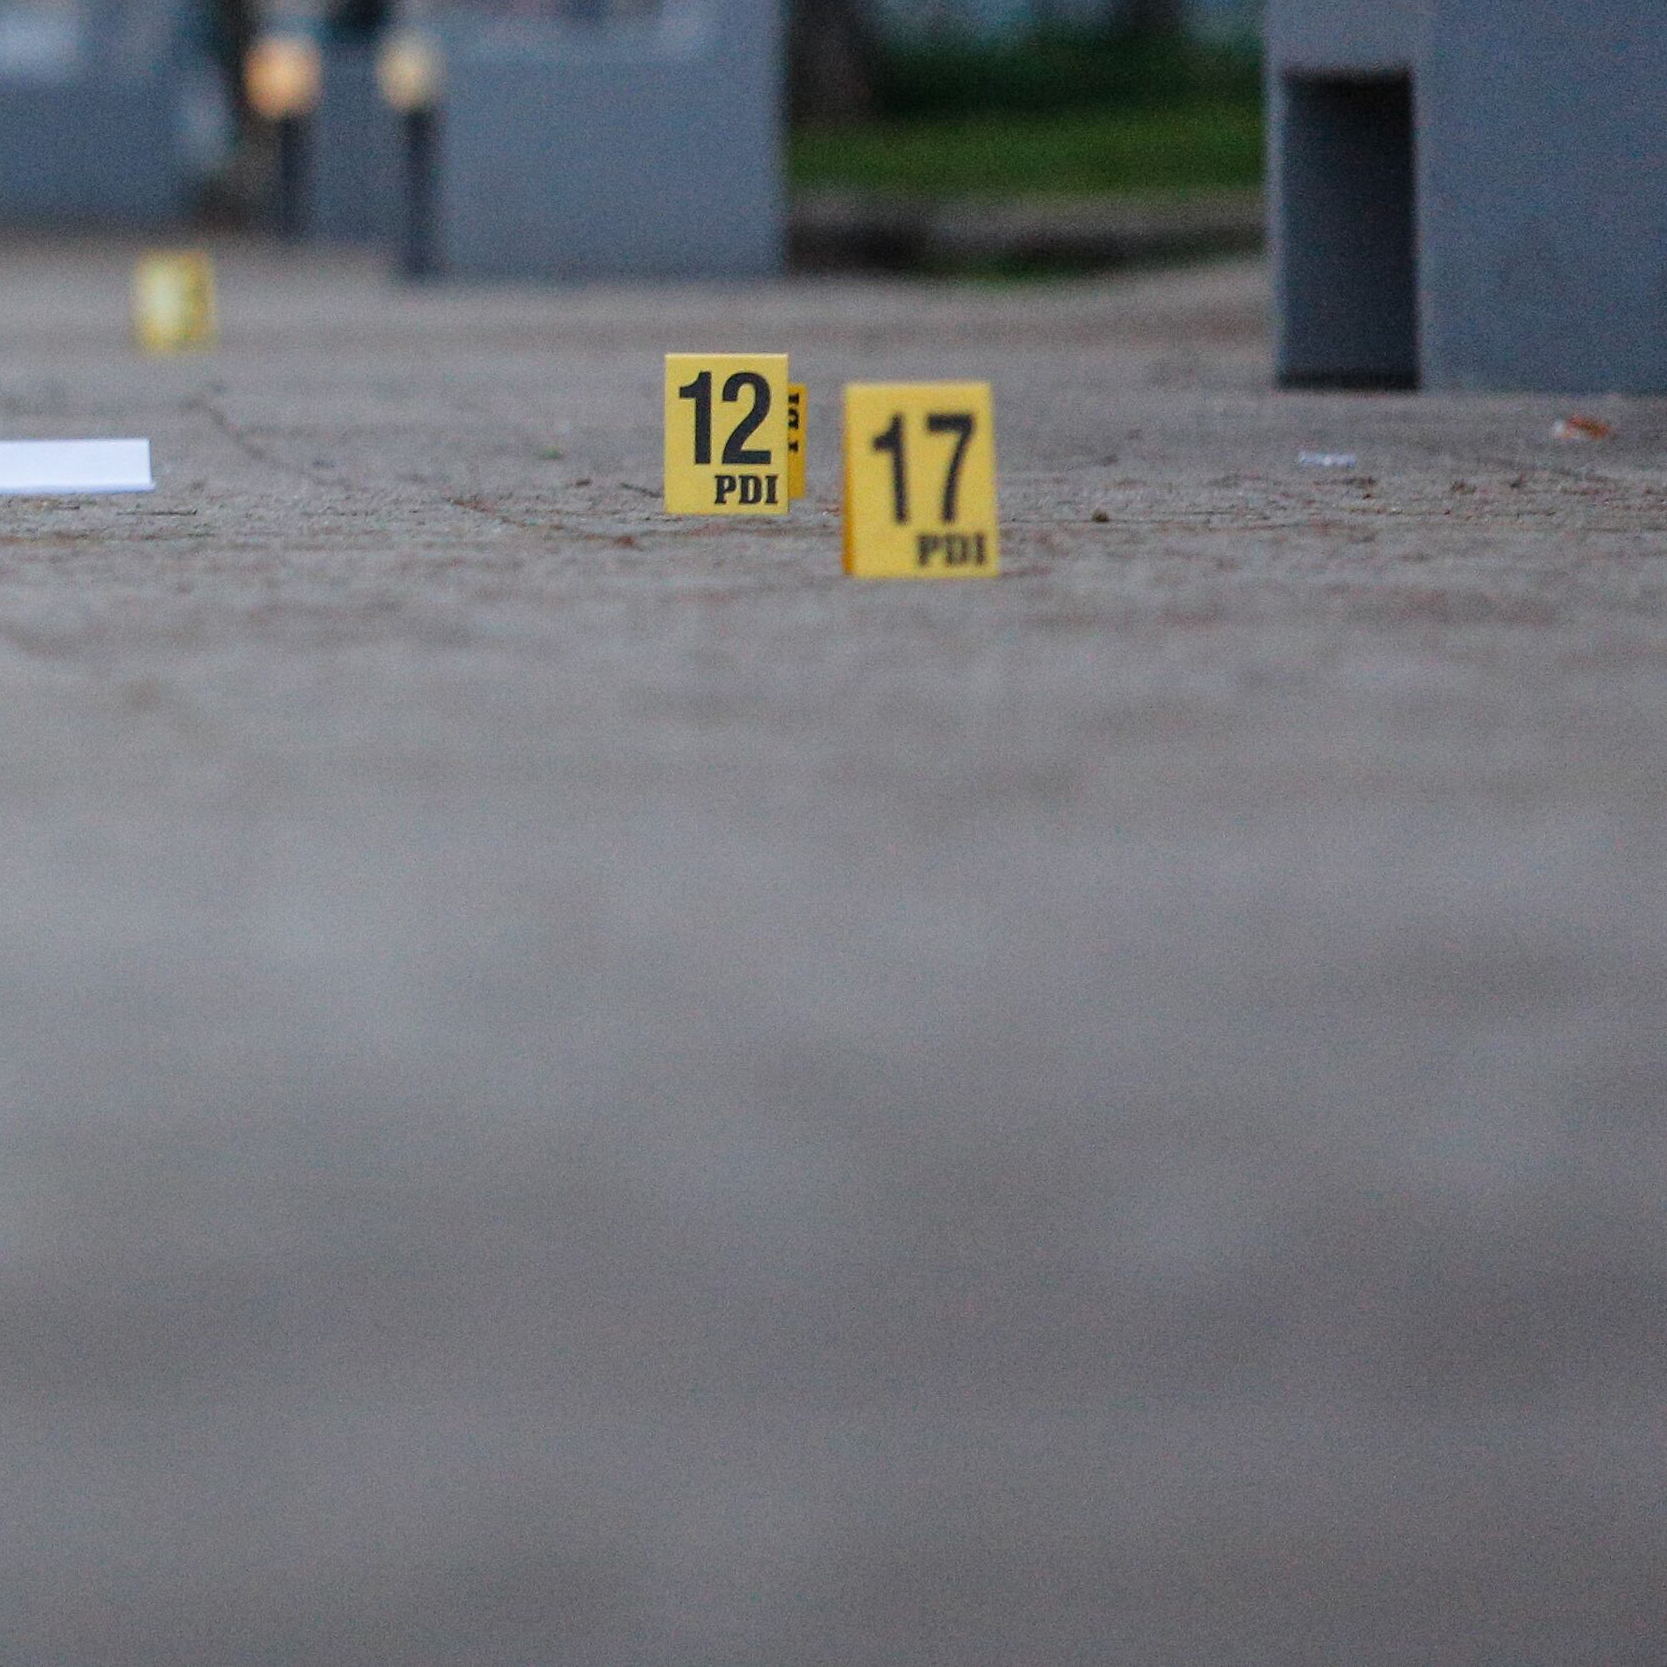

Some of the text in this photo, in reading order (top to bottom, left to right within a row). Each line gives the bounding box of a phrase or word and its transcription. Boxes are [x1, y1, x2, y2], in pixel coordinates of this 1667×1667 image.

[679, 371, 772, 464] 12
[714, 475, 779, 504] PDI
[873, 412, 975, 525] 17
[918, 535, 986, 567] PDI
